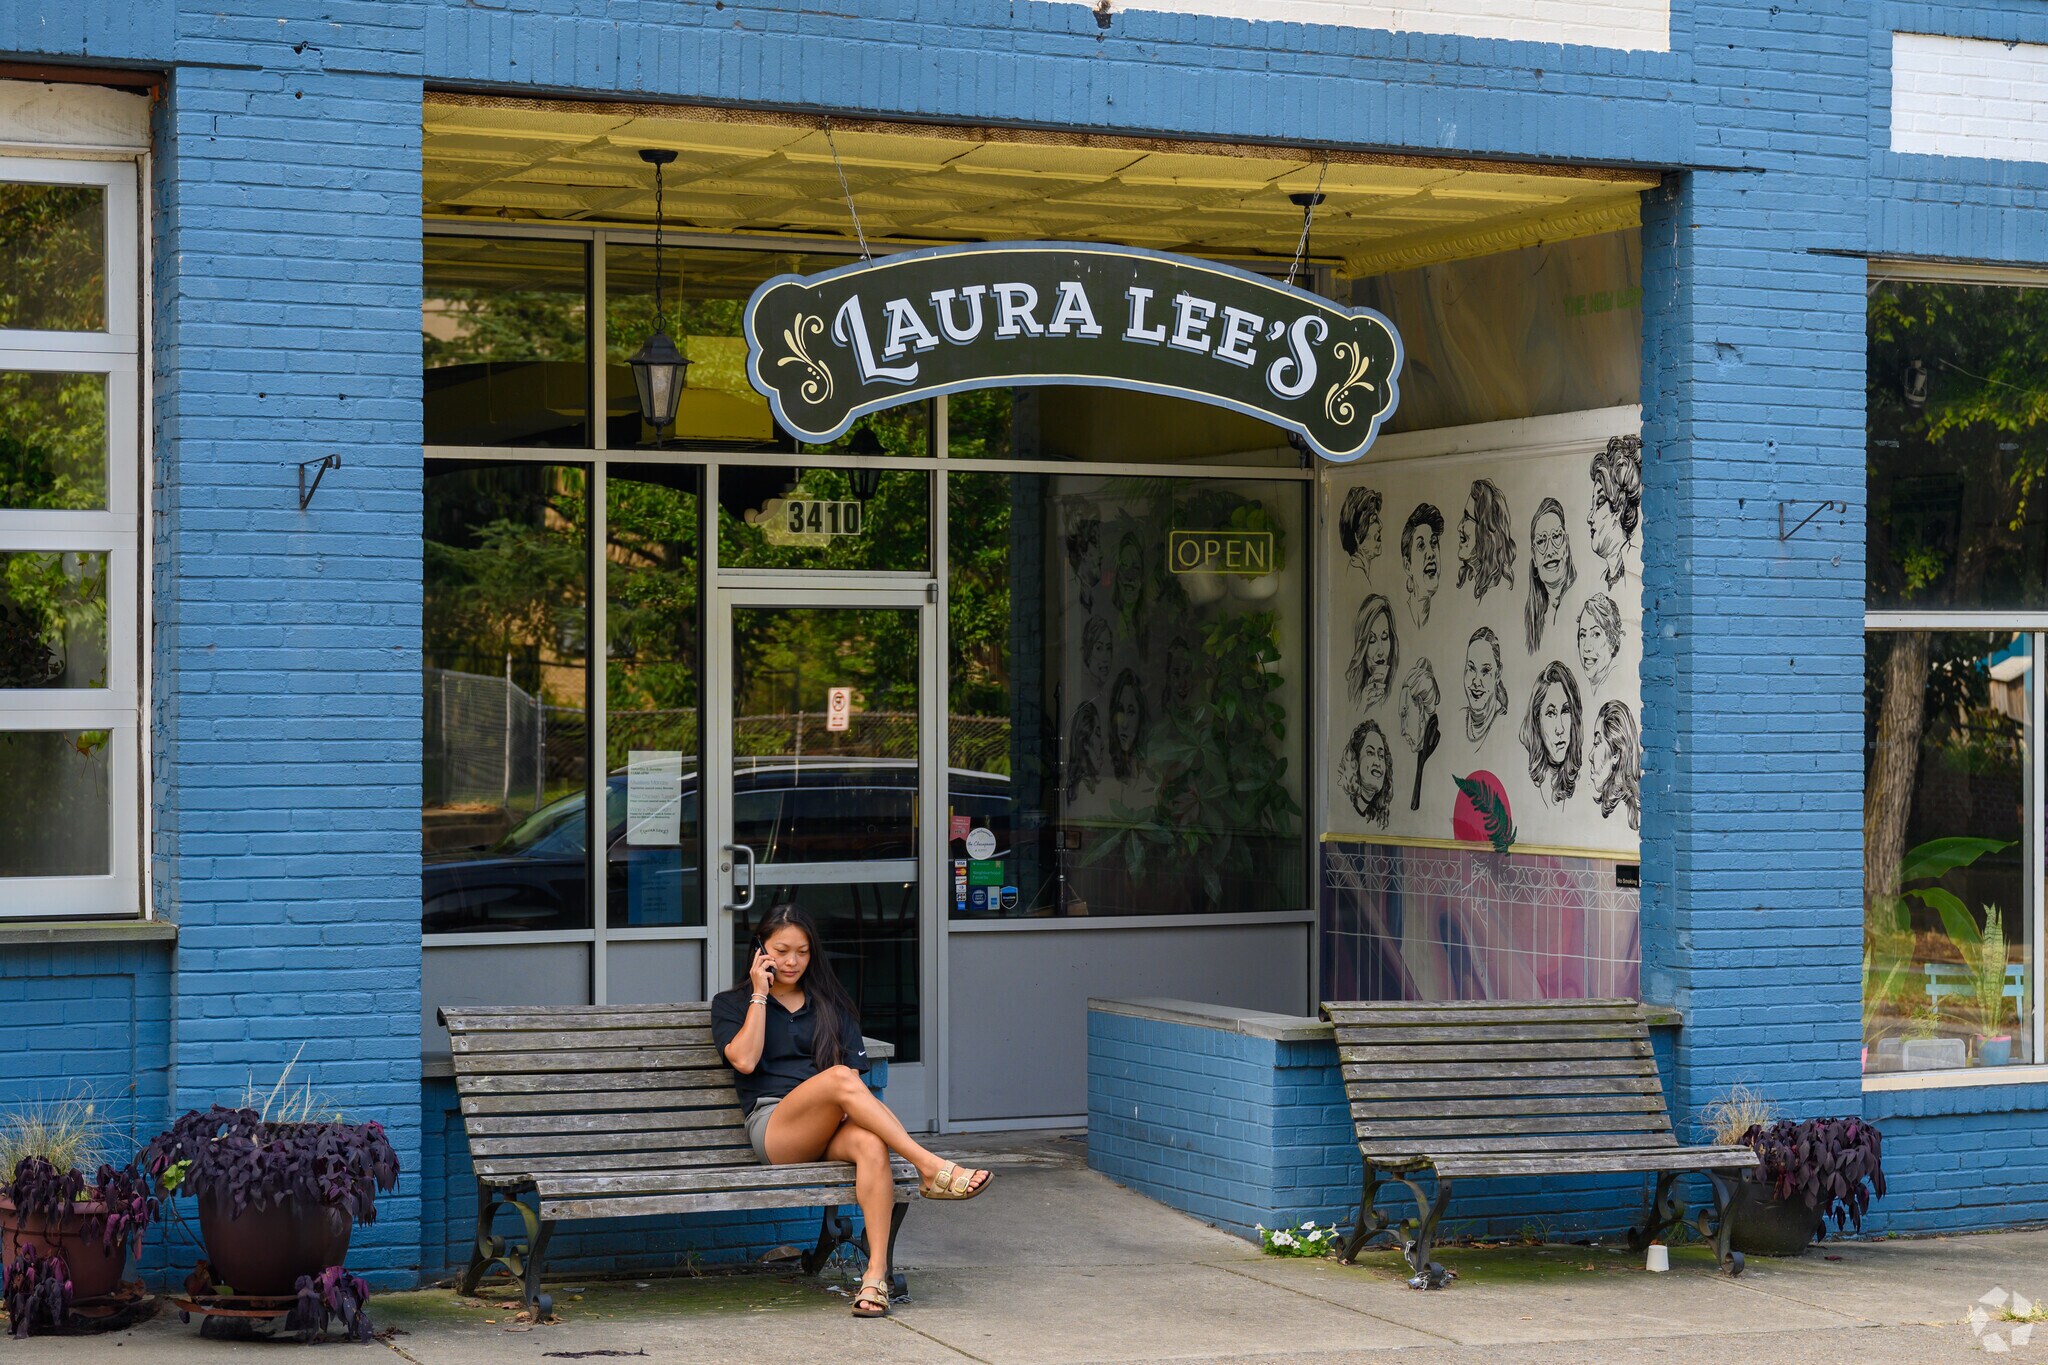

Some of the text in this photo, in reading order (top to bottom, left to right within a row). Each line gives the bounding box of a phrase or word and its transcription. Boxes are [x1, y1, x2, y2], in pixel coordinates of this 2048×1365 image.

[832, 280, 1329, 399] LAURA LEE'S
[789, 501, 859, 533] 3410
[1177, 539, 1264, 568] OPEN
